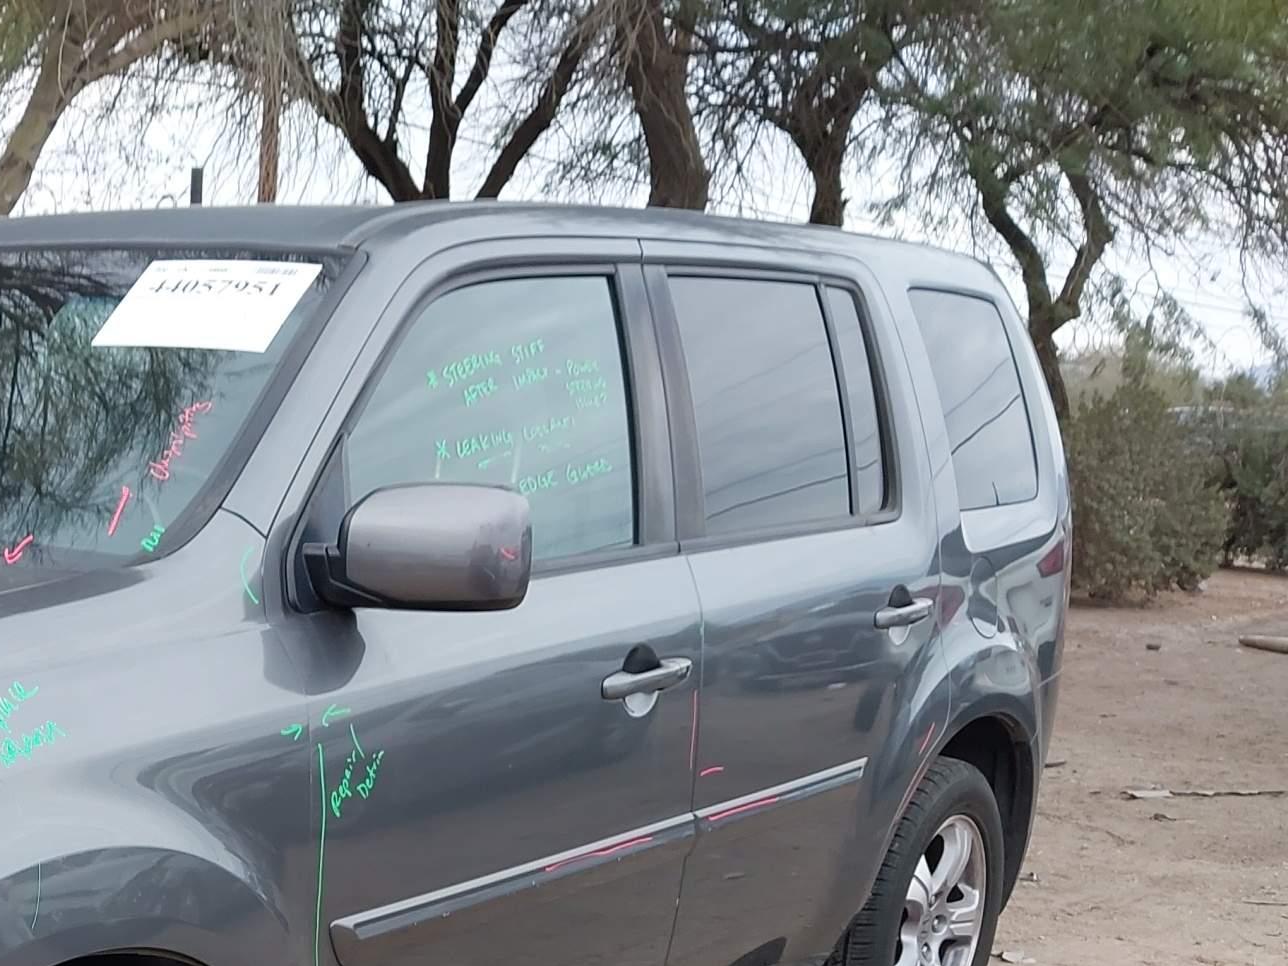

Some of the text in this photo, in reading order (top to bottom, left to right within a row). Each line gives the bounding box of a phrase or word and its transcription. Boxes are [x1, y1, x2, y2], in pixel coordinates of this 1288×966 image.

[149, 279, 280, 296] 44057951
[442, 338, 545, 387] STEERING STIFF
[463, 378, 498, 407] AFTER
[456, 430, 512, 458] LEAKING
